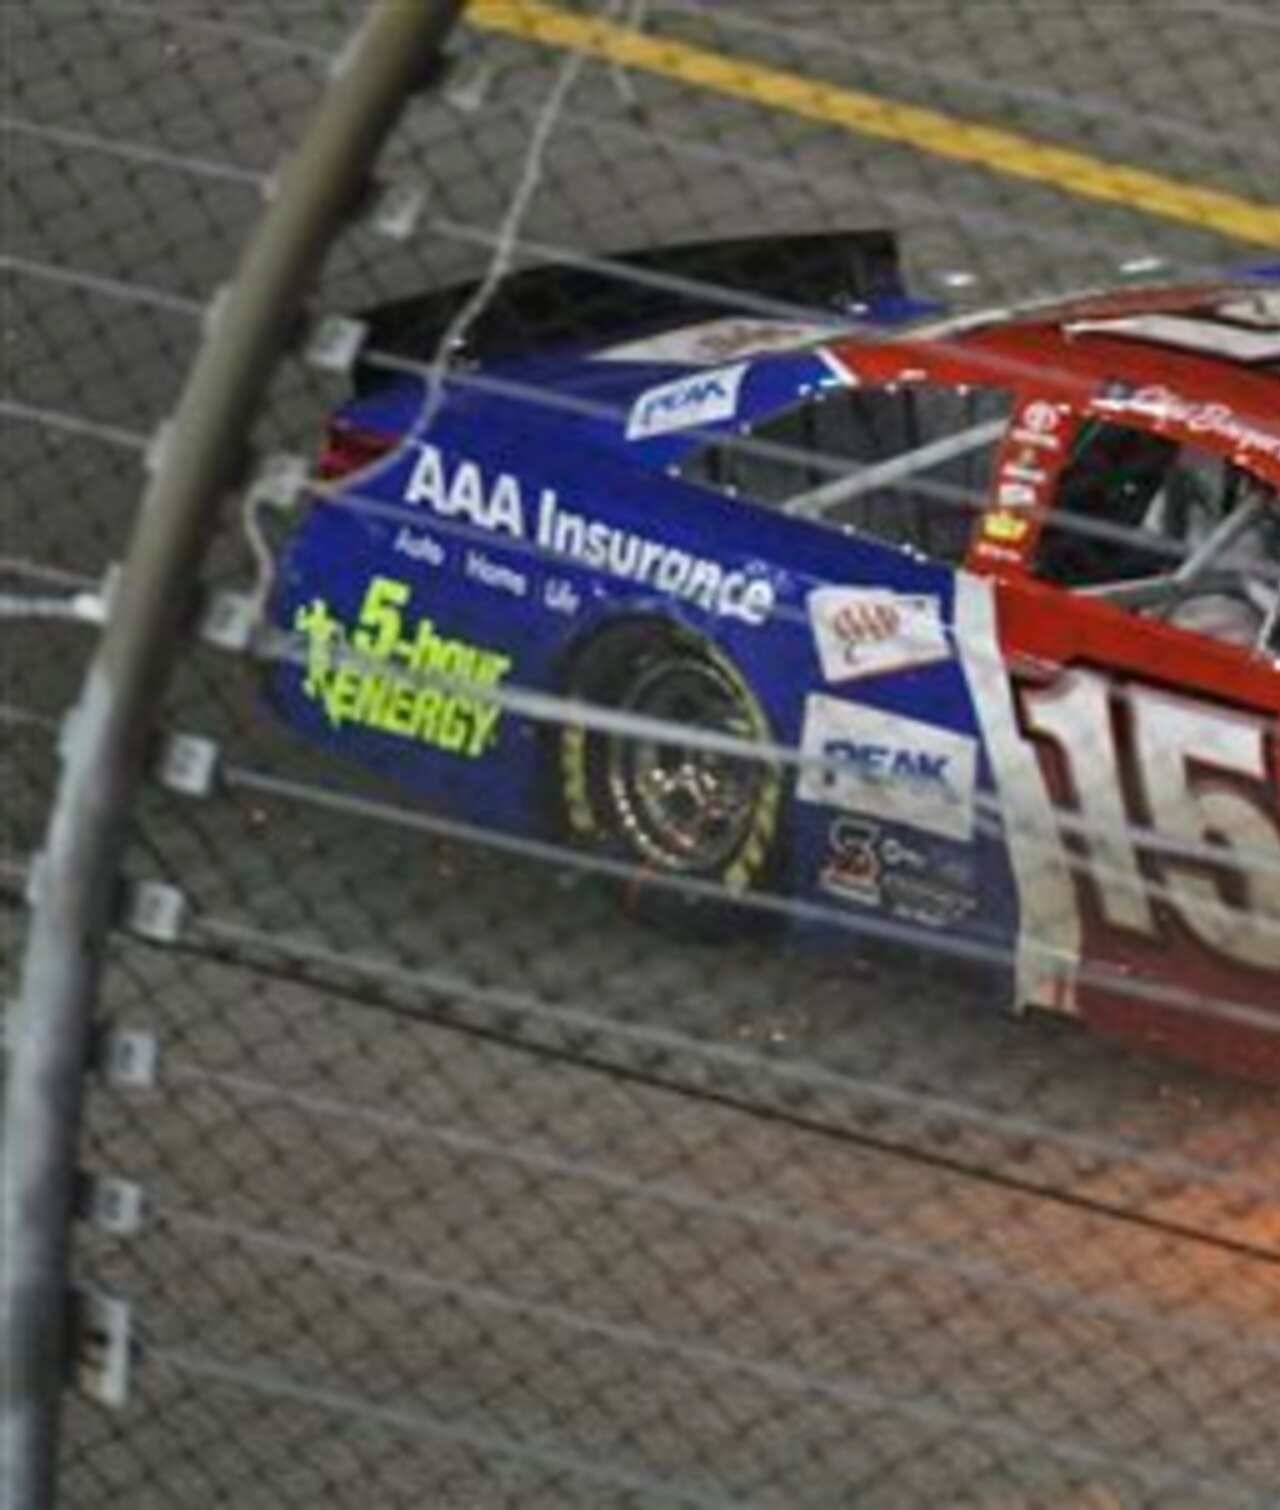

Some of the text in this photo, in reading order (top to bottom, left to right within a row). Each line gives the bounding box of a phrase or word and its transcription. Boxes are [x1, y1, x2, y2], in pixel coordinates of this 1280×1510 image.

[404, 443, 776, 625] AAA Insurance
[465, 549, 528, 596] Home
[353, 575, 512, 683] 5-hour
[334, 664, 502, 757] ENERGY
